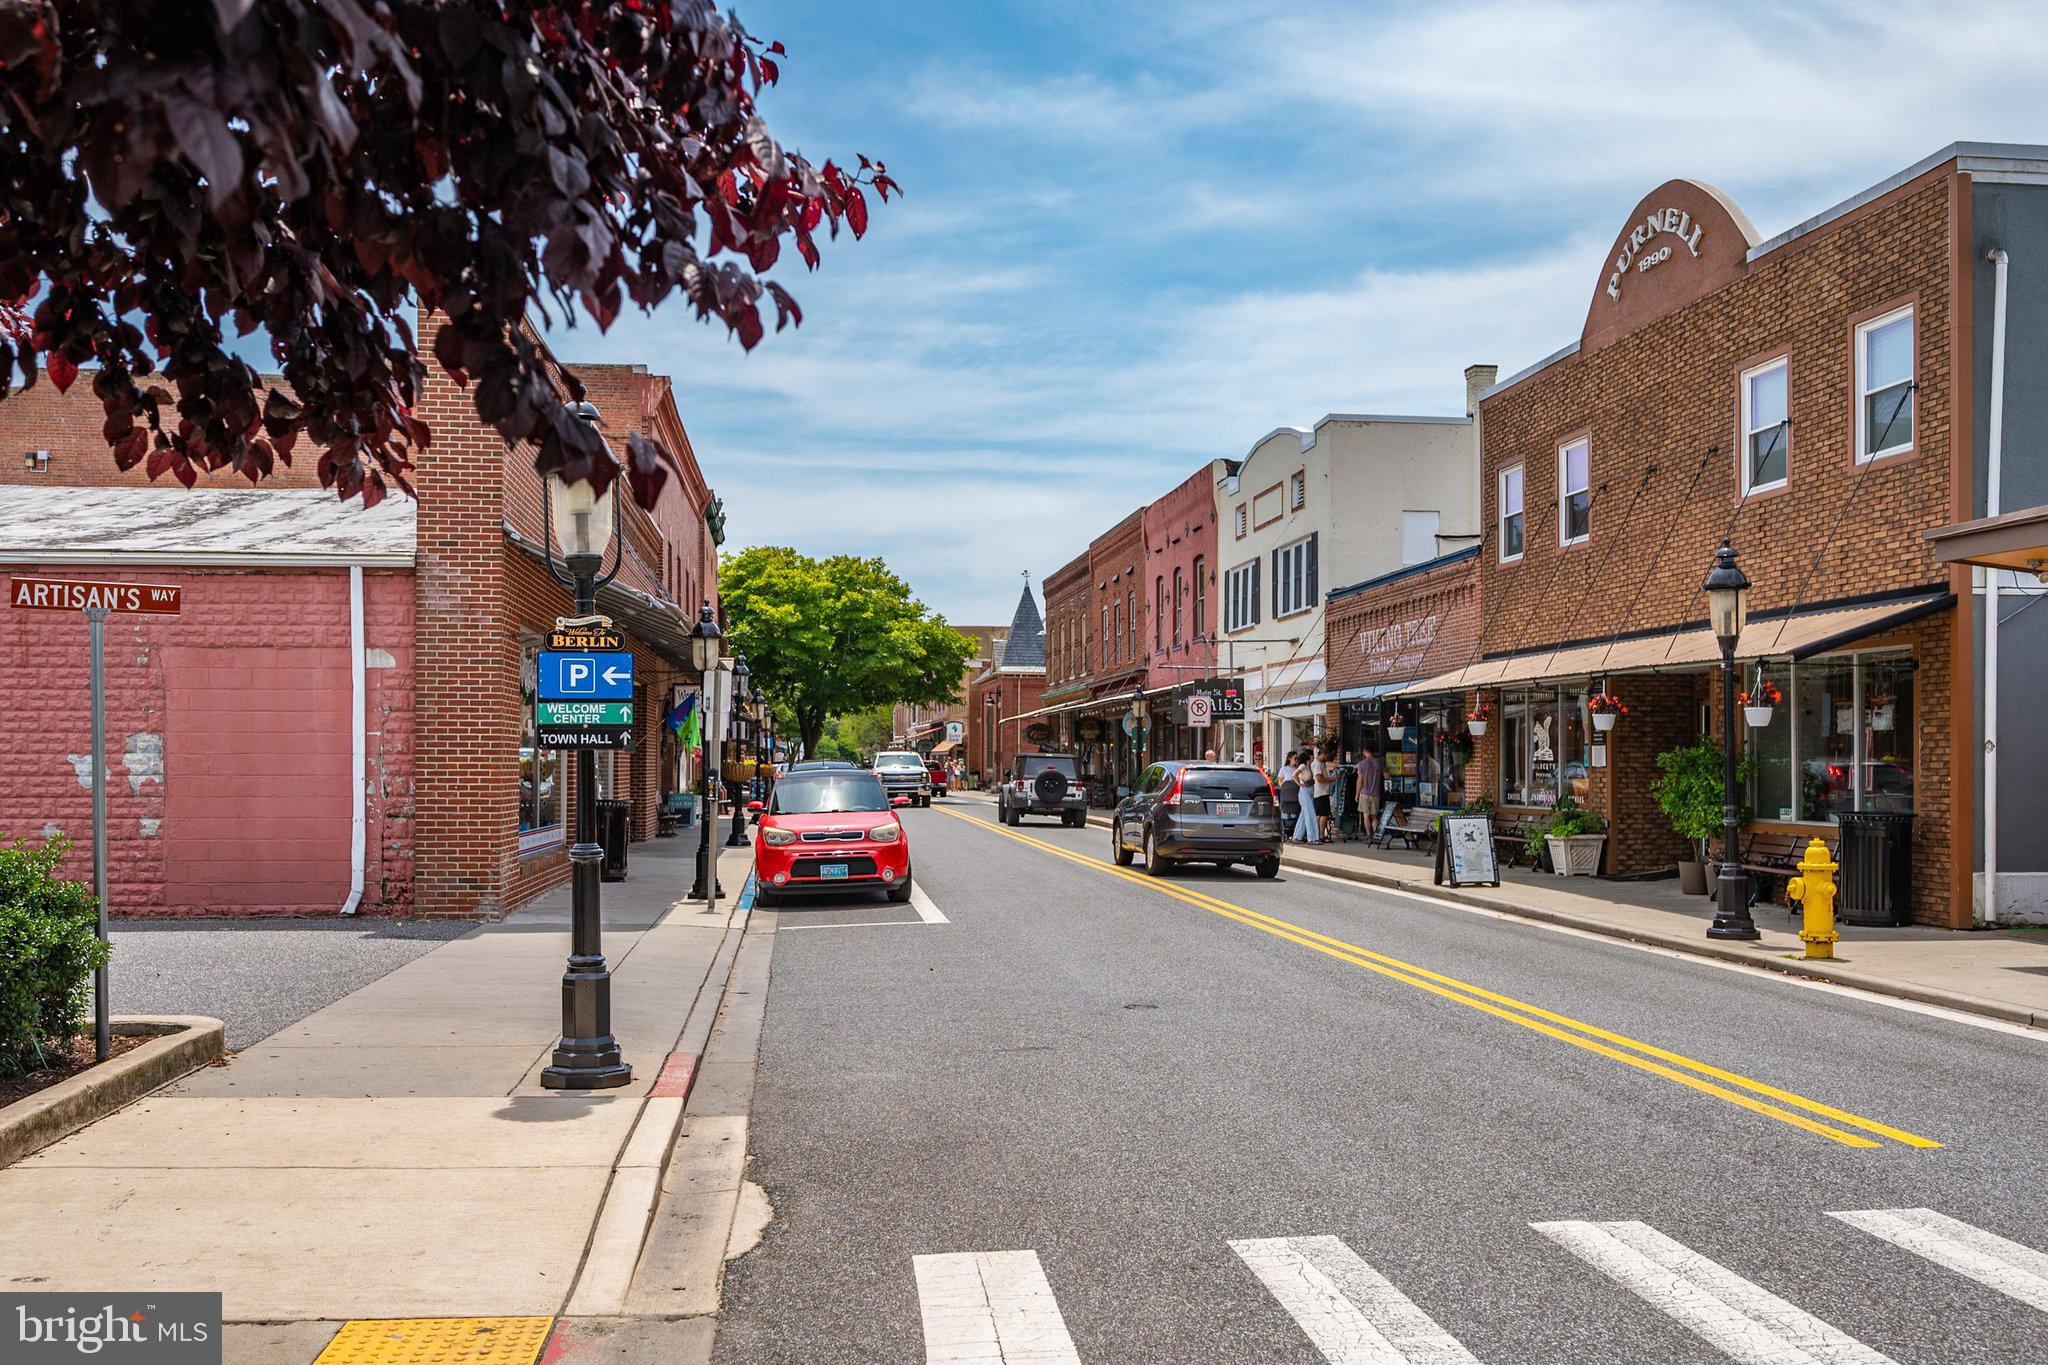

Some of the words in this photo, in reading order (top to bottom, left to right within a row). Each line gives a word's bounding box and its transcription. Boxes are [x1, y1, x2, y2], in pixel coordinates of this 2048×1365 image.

[1606, 207, 1704, 302] PURNELL
[1637, 246, 1672, 273] 1990
[16, 583, 141, 611] ARTISAN'S
[151, 589, 176, 602] WAY
[552, 634, 619, 647] BERLIN
[1360, 623, 1402, 655] VIKING
[570, 664, 589, 687] P
[547, 704, 607, 713] WELCOME
[553, 714, 600, 723] CENTER
[541, 734, 577, 744] TOWN
[580, 734, 612, 744] HALL
